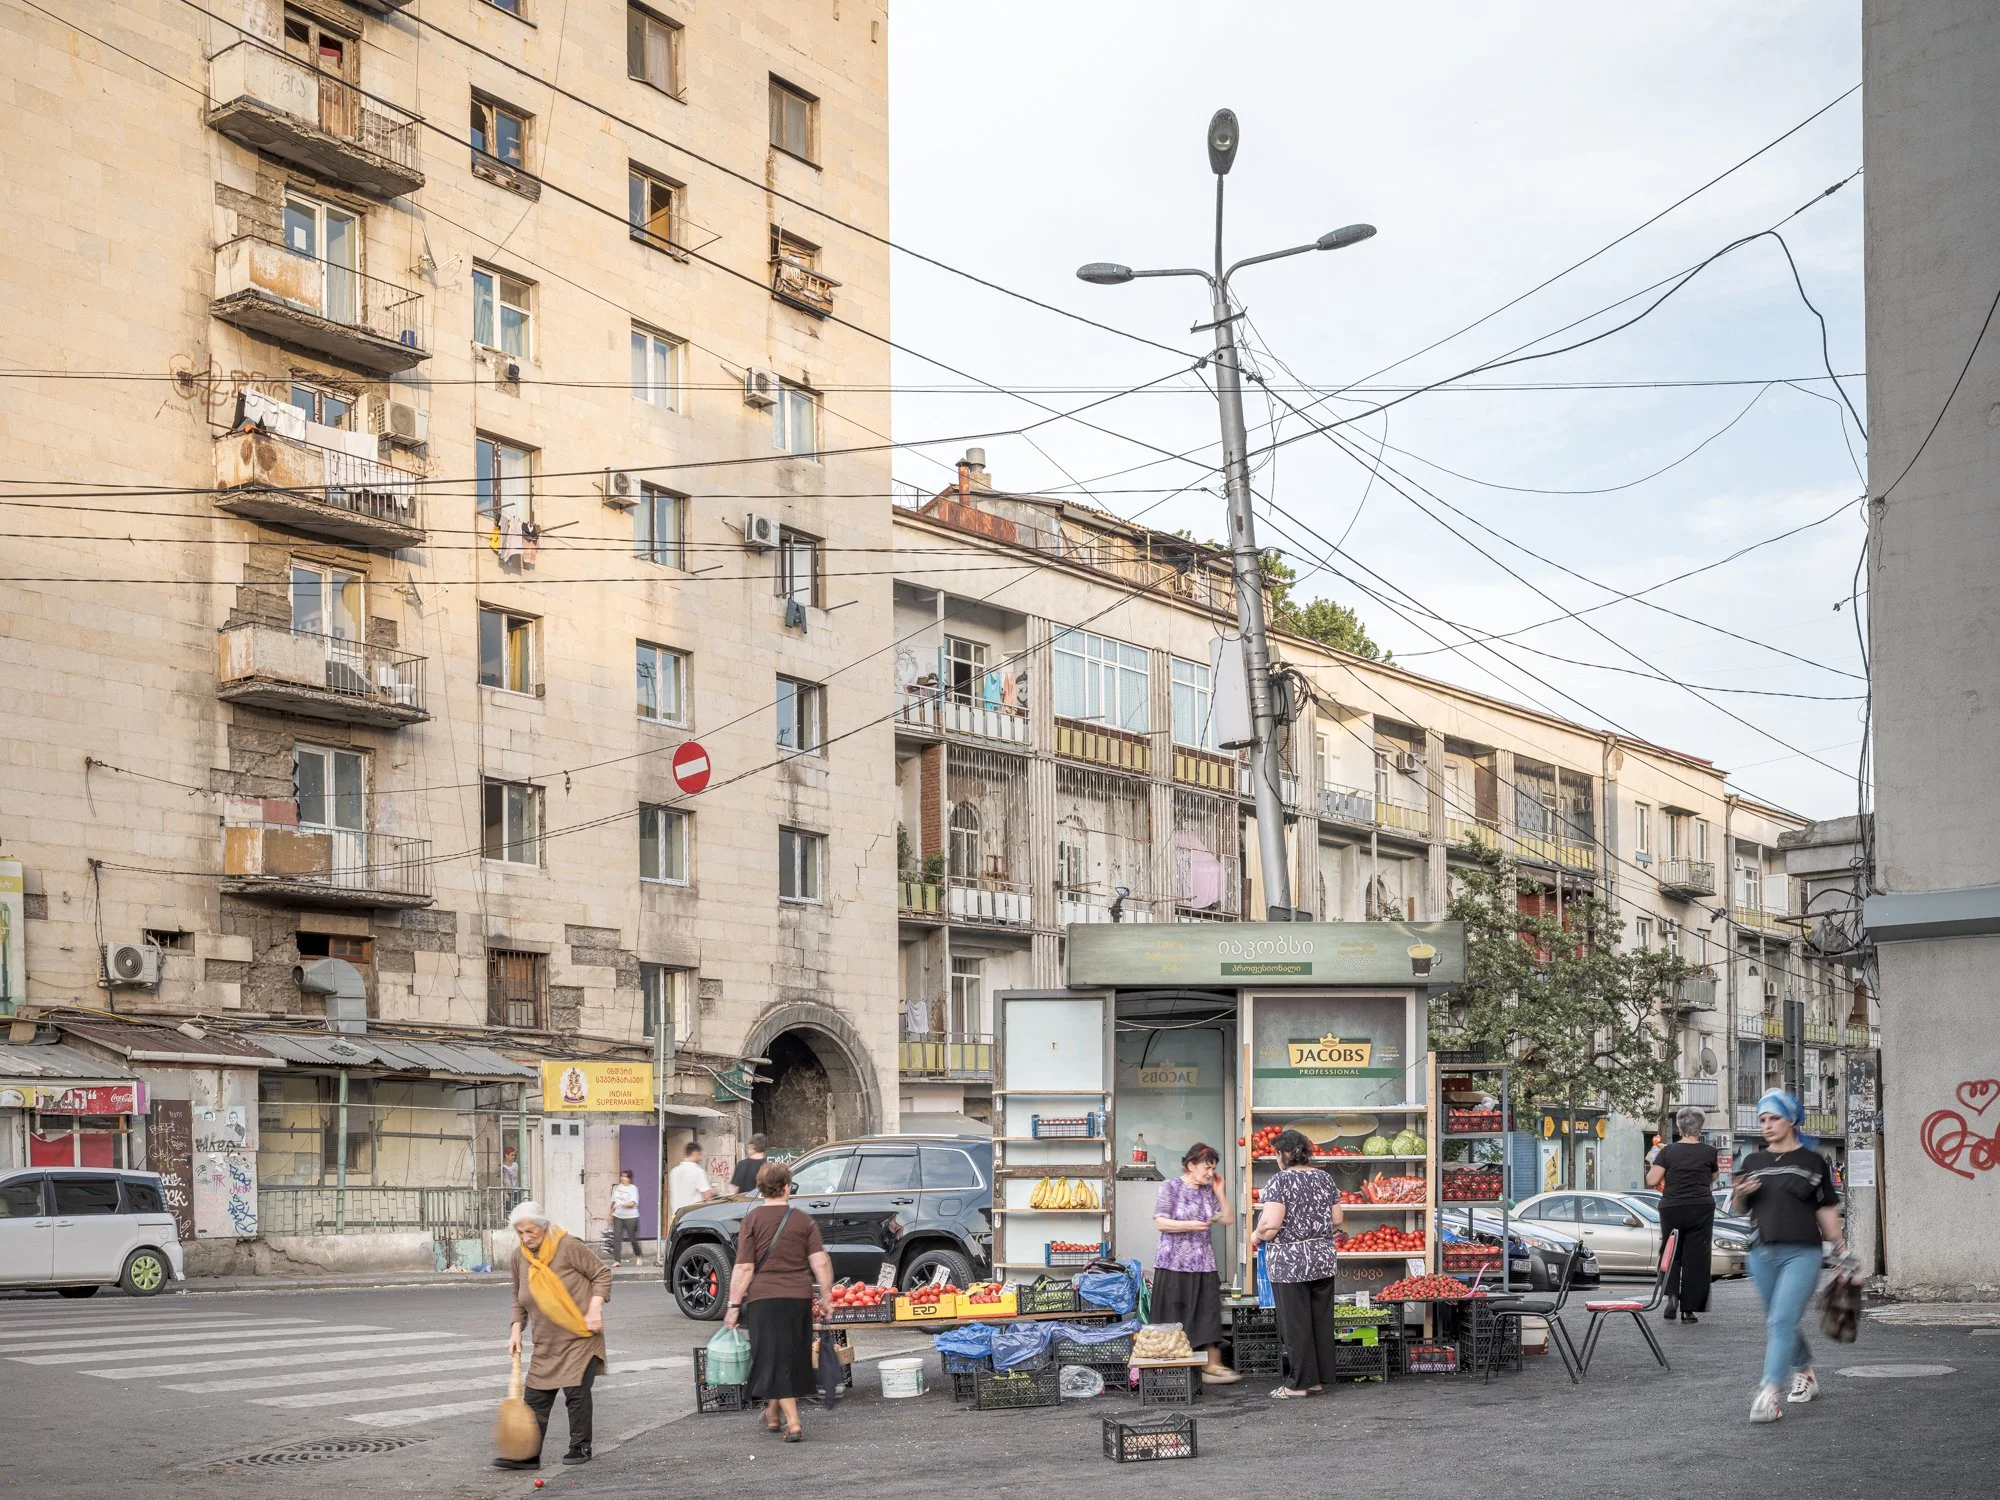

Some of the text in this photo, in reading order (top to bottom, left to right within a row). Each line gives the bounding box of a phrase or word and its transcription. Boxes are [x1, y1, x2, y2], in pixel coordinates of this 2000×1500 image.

[1218, 936, 1314, 960] იაკობსი
[1232, 964, 1301, 974] პროფესიონალი
[1295, 1048, 1364, 1064] JACOBS
[1299, 1068, 1360, 1076] PROFESSIONAL
[596, 1098, 644, 1106] SUPERMARKET
[1353, 1267, 1384, 1281] ყავა
[912, 1305, 937, 1316] ERD
